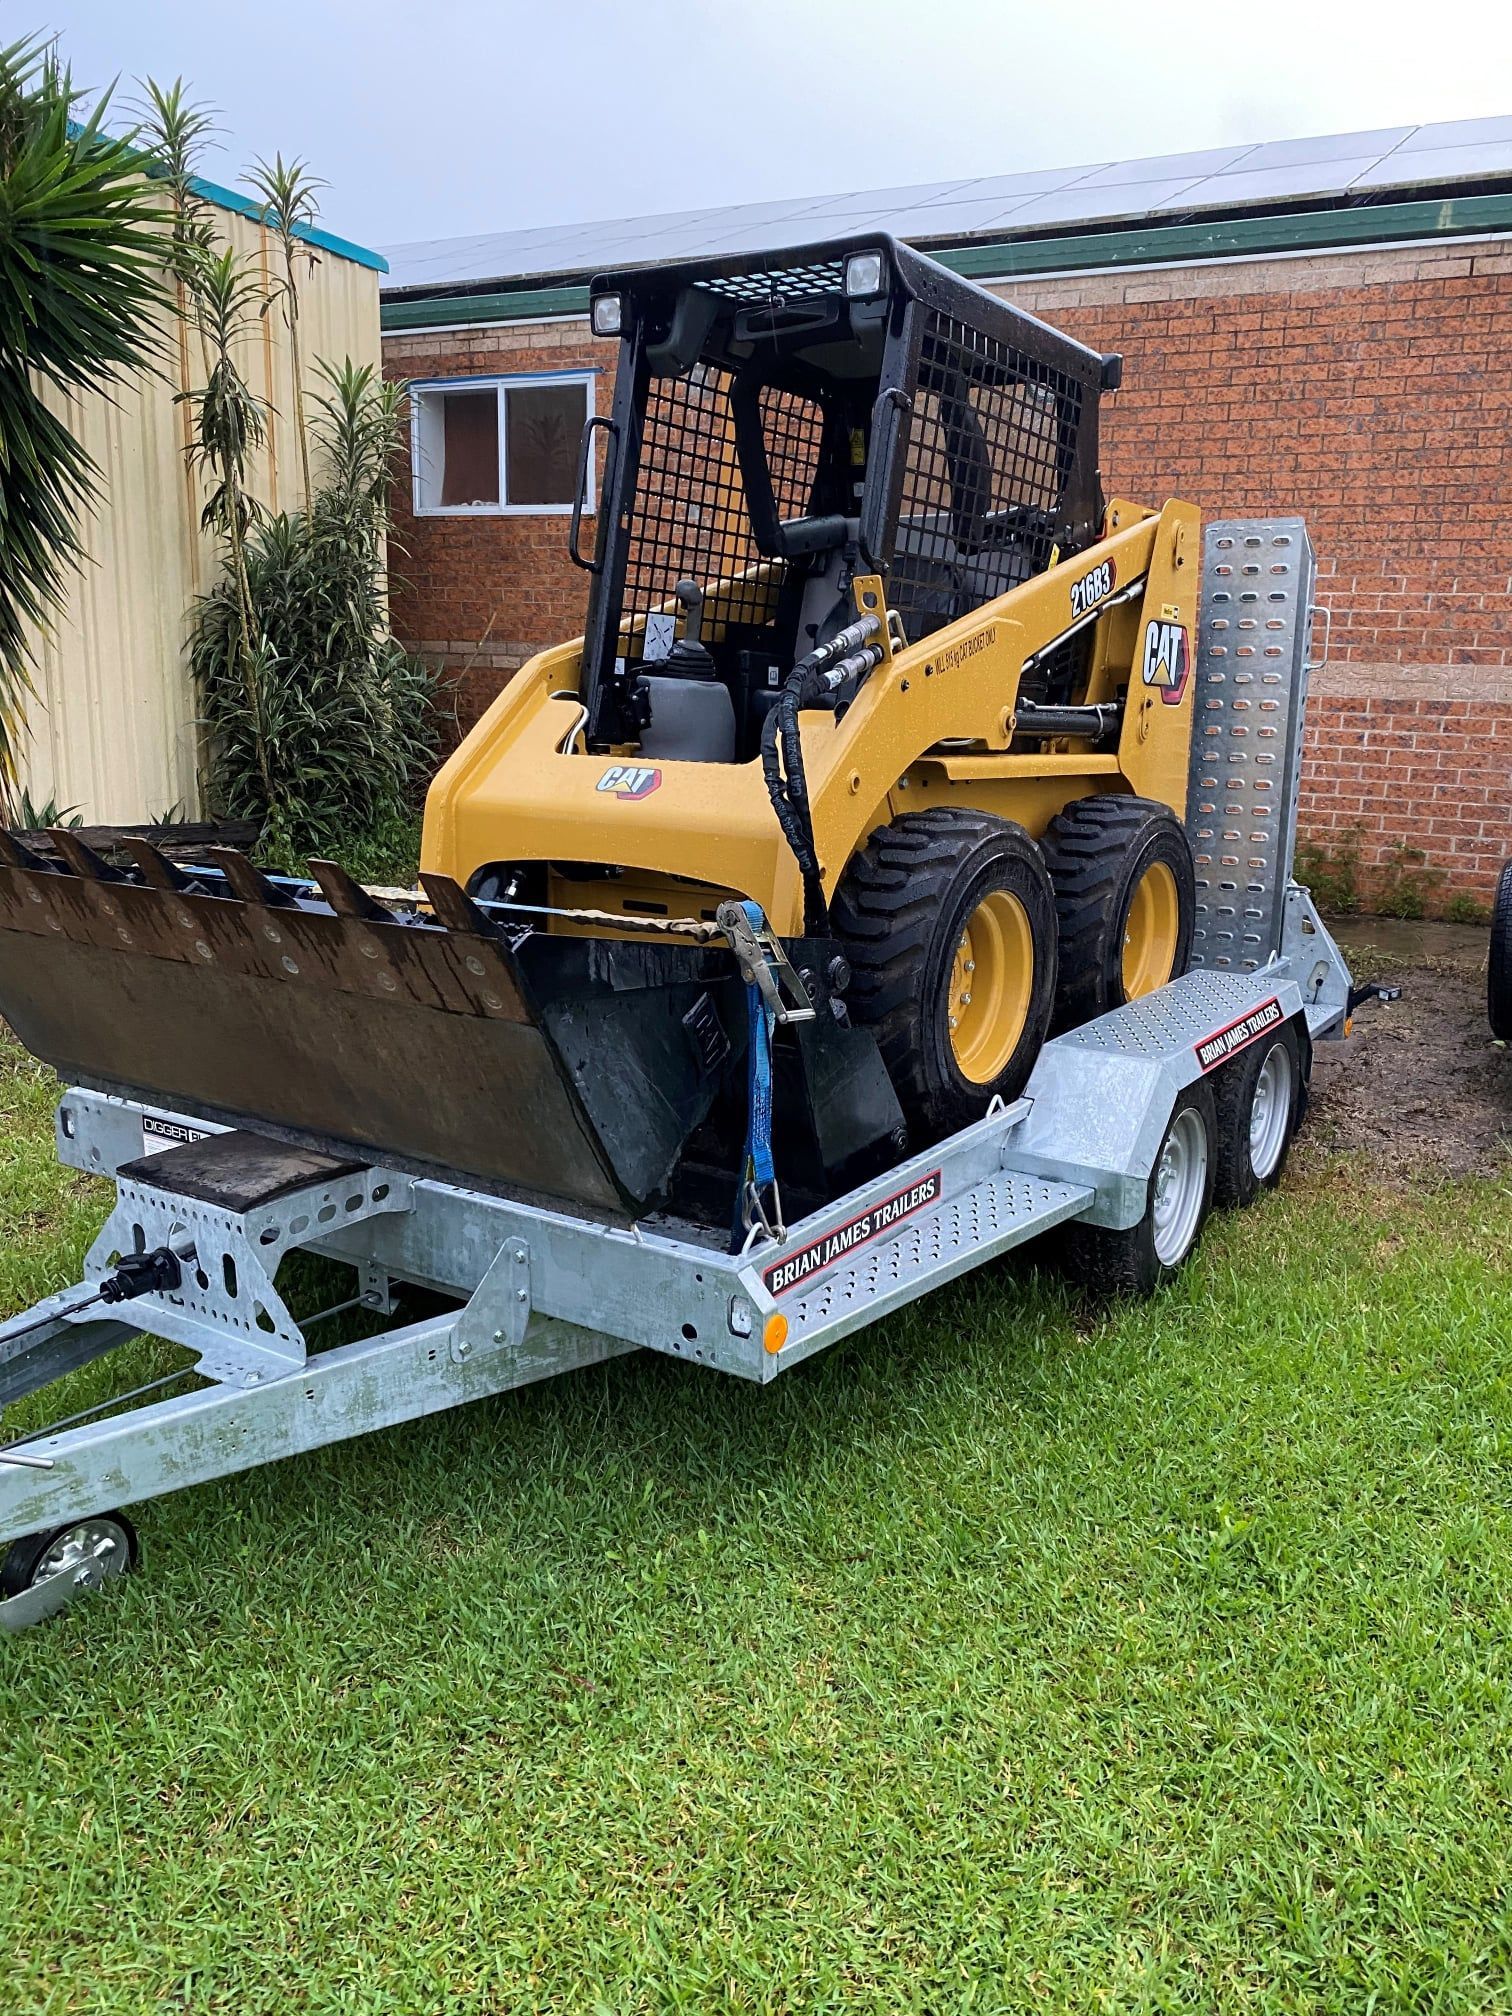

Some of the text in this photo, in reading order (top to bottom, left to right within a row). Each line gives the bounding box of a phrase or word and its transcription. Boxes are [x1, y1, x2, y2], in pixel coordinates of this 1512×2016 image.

[1071, 562, 1111, 618] 216B3
[1143, 620, 1184, 686] CAT
[596, 765, 656, 789] CAT
[791, 774, 803, 796] CAT
[1199, 1002, 1280, 1065] BRIAN JAMES TRAILERS
[143, 1117, 189, 1141] DIGGER
[772, 1178, 936, 1293] BRIAN JAMES TRAILERS
